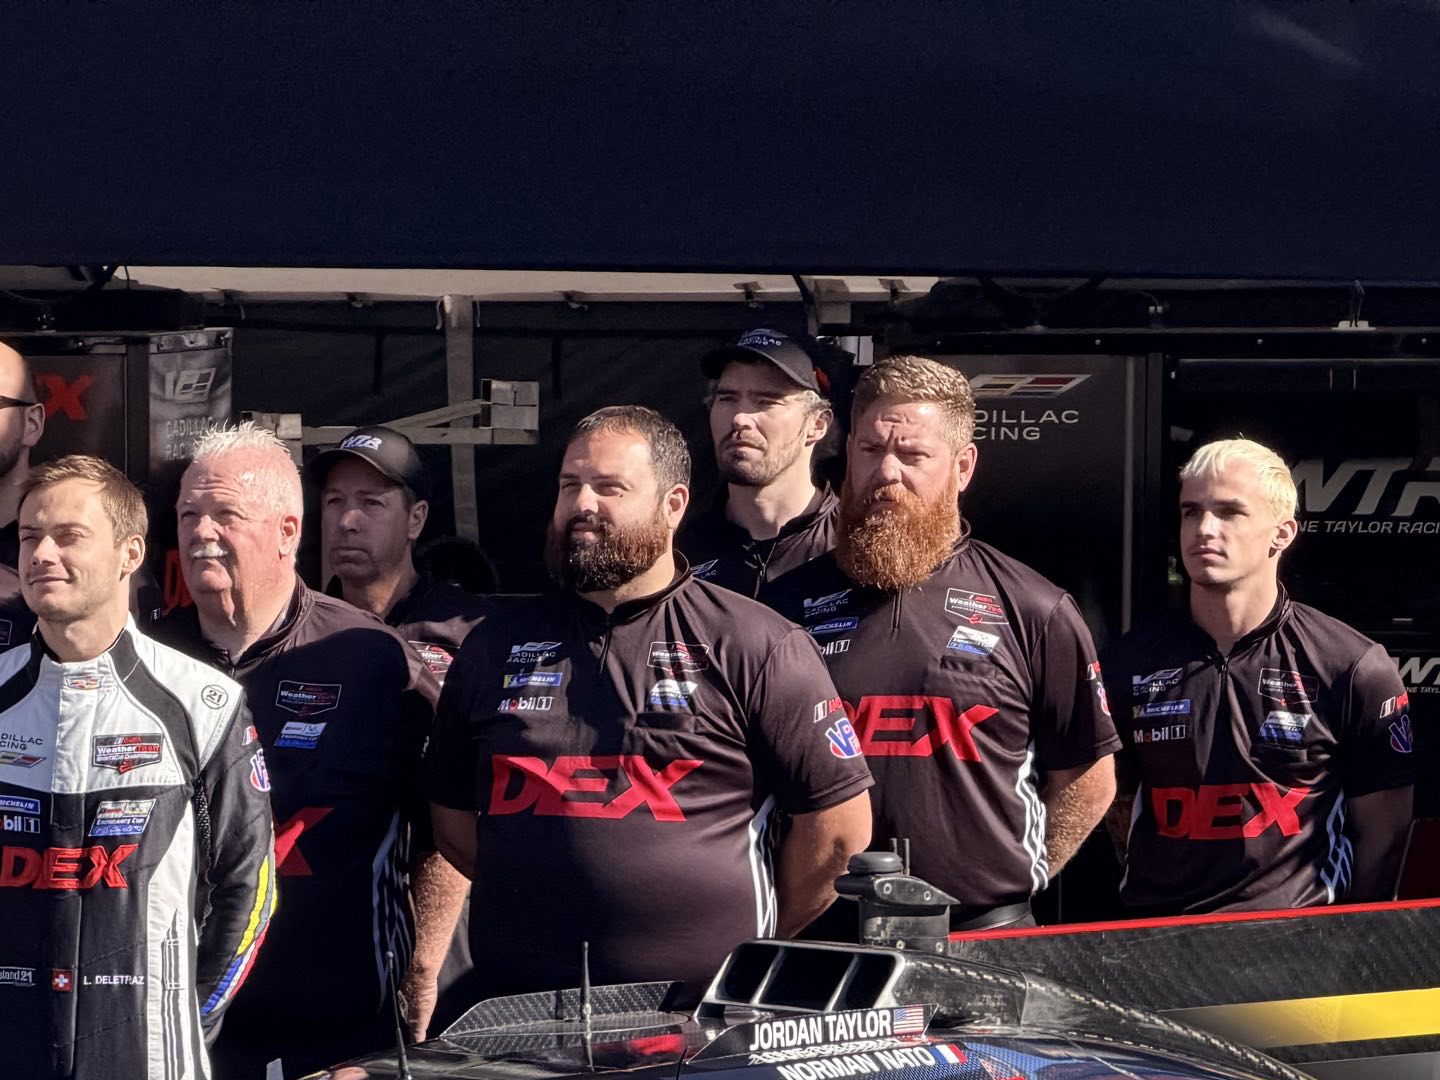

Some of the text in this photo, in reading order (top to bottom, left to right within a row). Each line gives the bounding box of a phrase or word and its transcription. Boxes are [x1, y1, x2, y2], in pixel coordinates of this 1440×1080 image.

[974, 410, 1079, 424] DILLAC
[972, 426, 1040, 440] CING
[1324, 520, 1393, 534] TAYLOR
[1398, 521, 1440, 534] RACI
[498, 696, 536, 711] Mobil
[1133, 726, 1169, 743] Mobil
[488, 754, 704, 821] DEX
[1152, 782, 1312, 840] DEX
[0, 843, 138, 889] DEX
[83, 975, 145, 986] L. DELETRAZ
[749, 1009, 892, 1052] JORDAN TAYLOR
[876, 1046, 936, 1072] NATO
